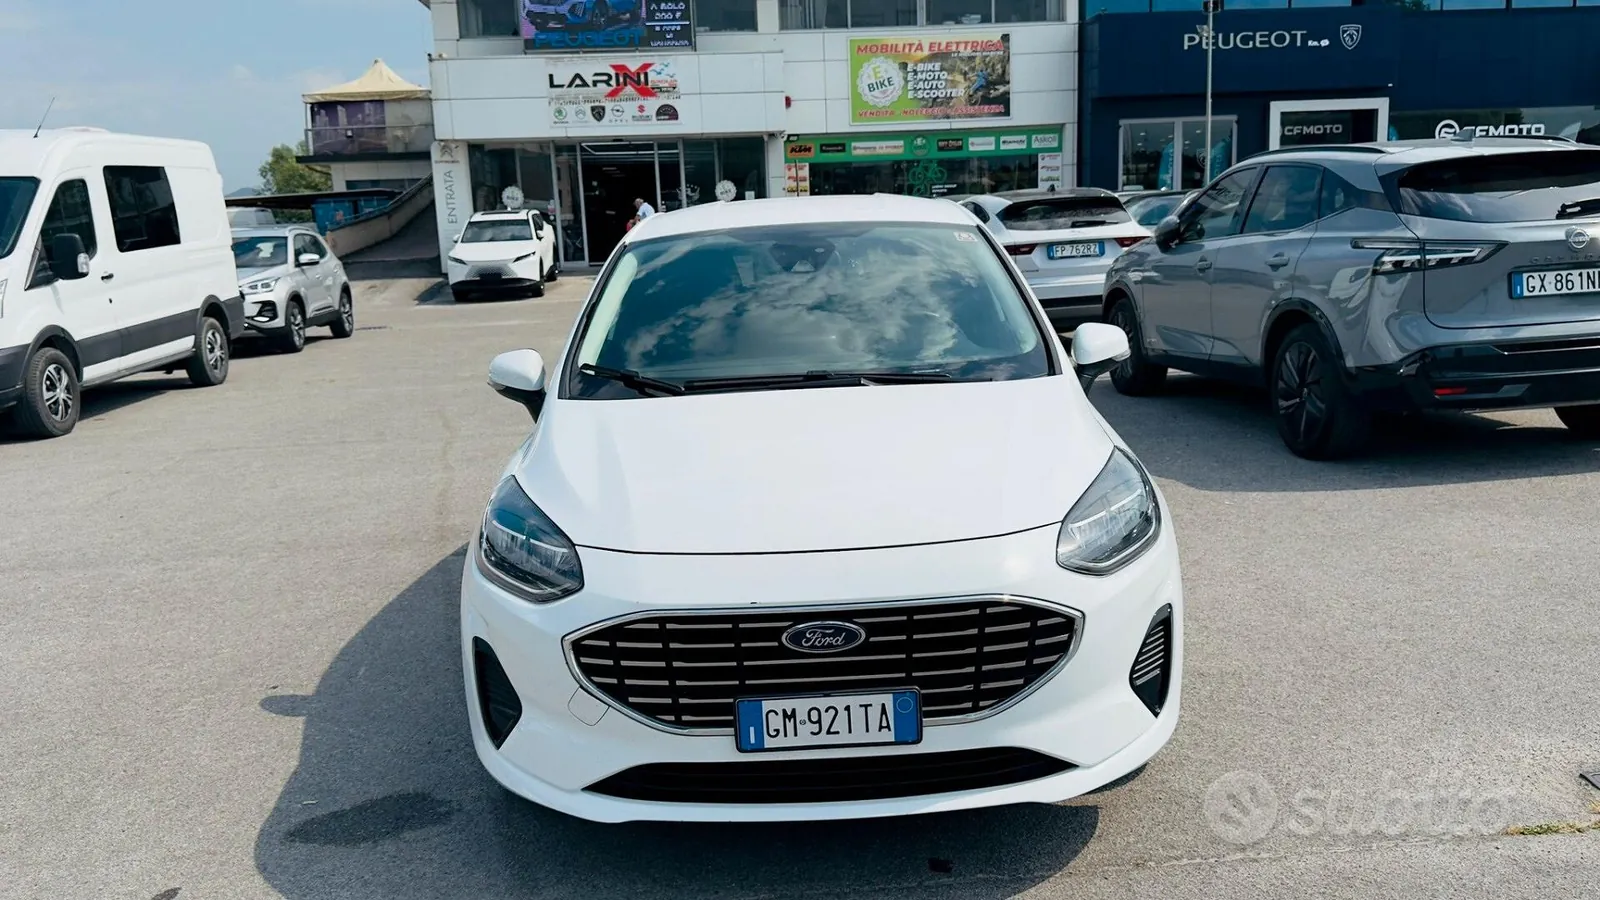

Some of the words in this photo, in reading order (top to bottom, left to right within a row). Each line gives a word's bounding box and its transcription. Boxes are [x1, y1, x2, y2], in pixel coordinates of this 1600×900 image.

[534, 28, 643, 47] PEUGEOT
[1183, 30, 1307, 50] PEUGEOT
[856, 40, 924, 55] MOBILITÀ
[928, 39, 1005, 53] ELETTRICA
[870, 65, 881, 79] E
[907, 62, 941, 72] E-BIKE
[907, 71, 948, 81] E-MOTO
[867, 77, 895, 93] BIKE
[907, 80, 946, 90] E-AUTO
[907, 88, 965, 99] E-SCOOTER
[858, 110, 895, 118] VENDITA
[1283, 124, 1343, 136] CFMOTO
[443, 169, 458, 224] ENTRATA
[1055, 246, 1066, 256] FP
[1070, 243, 1098, 255] 762RZ
[1526, 273, 1547, 294] GX
[801, 628, 846, 647] Ford
[765, 707, 798, 739] GM
[807, 702, 892, 737] 921TA
